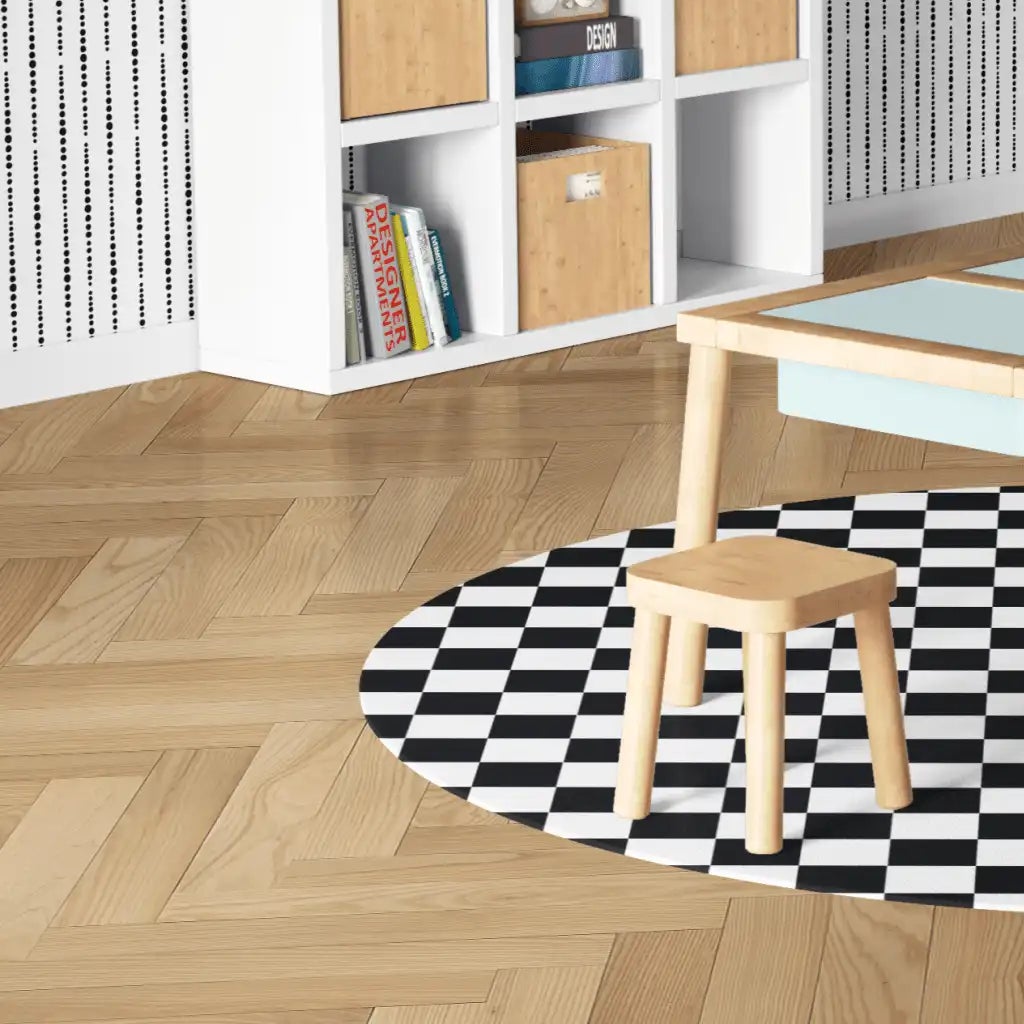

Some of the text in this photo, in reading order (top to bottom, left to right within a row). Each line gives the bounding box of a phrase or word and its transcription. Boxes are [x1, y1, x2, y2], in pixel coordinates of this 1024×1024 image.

[586, 22, 617, 51] DESIGN
[364, 208, 396, 352] APARTMENTS
[375, 202, 407, 345] DESIGNER
